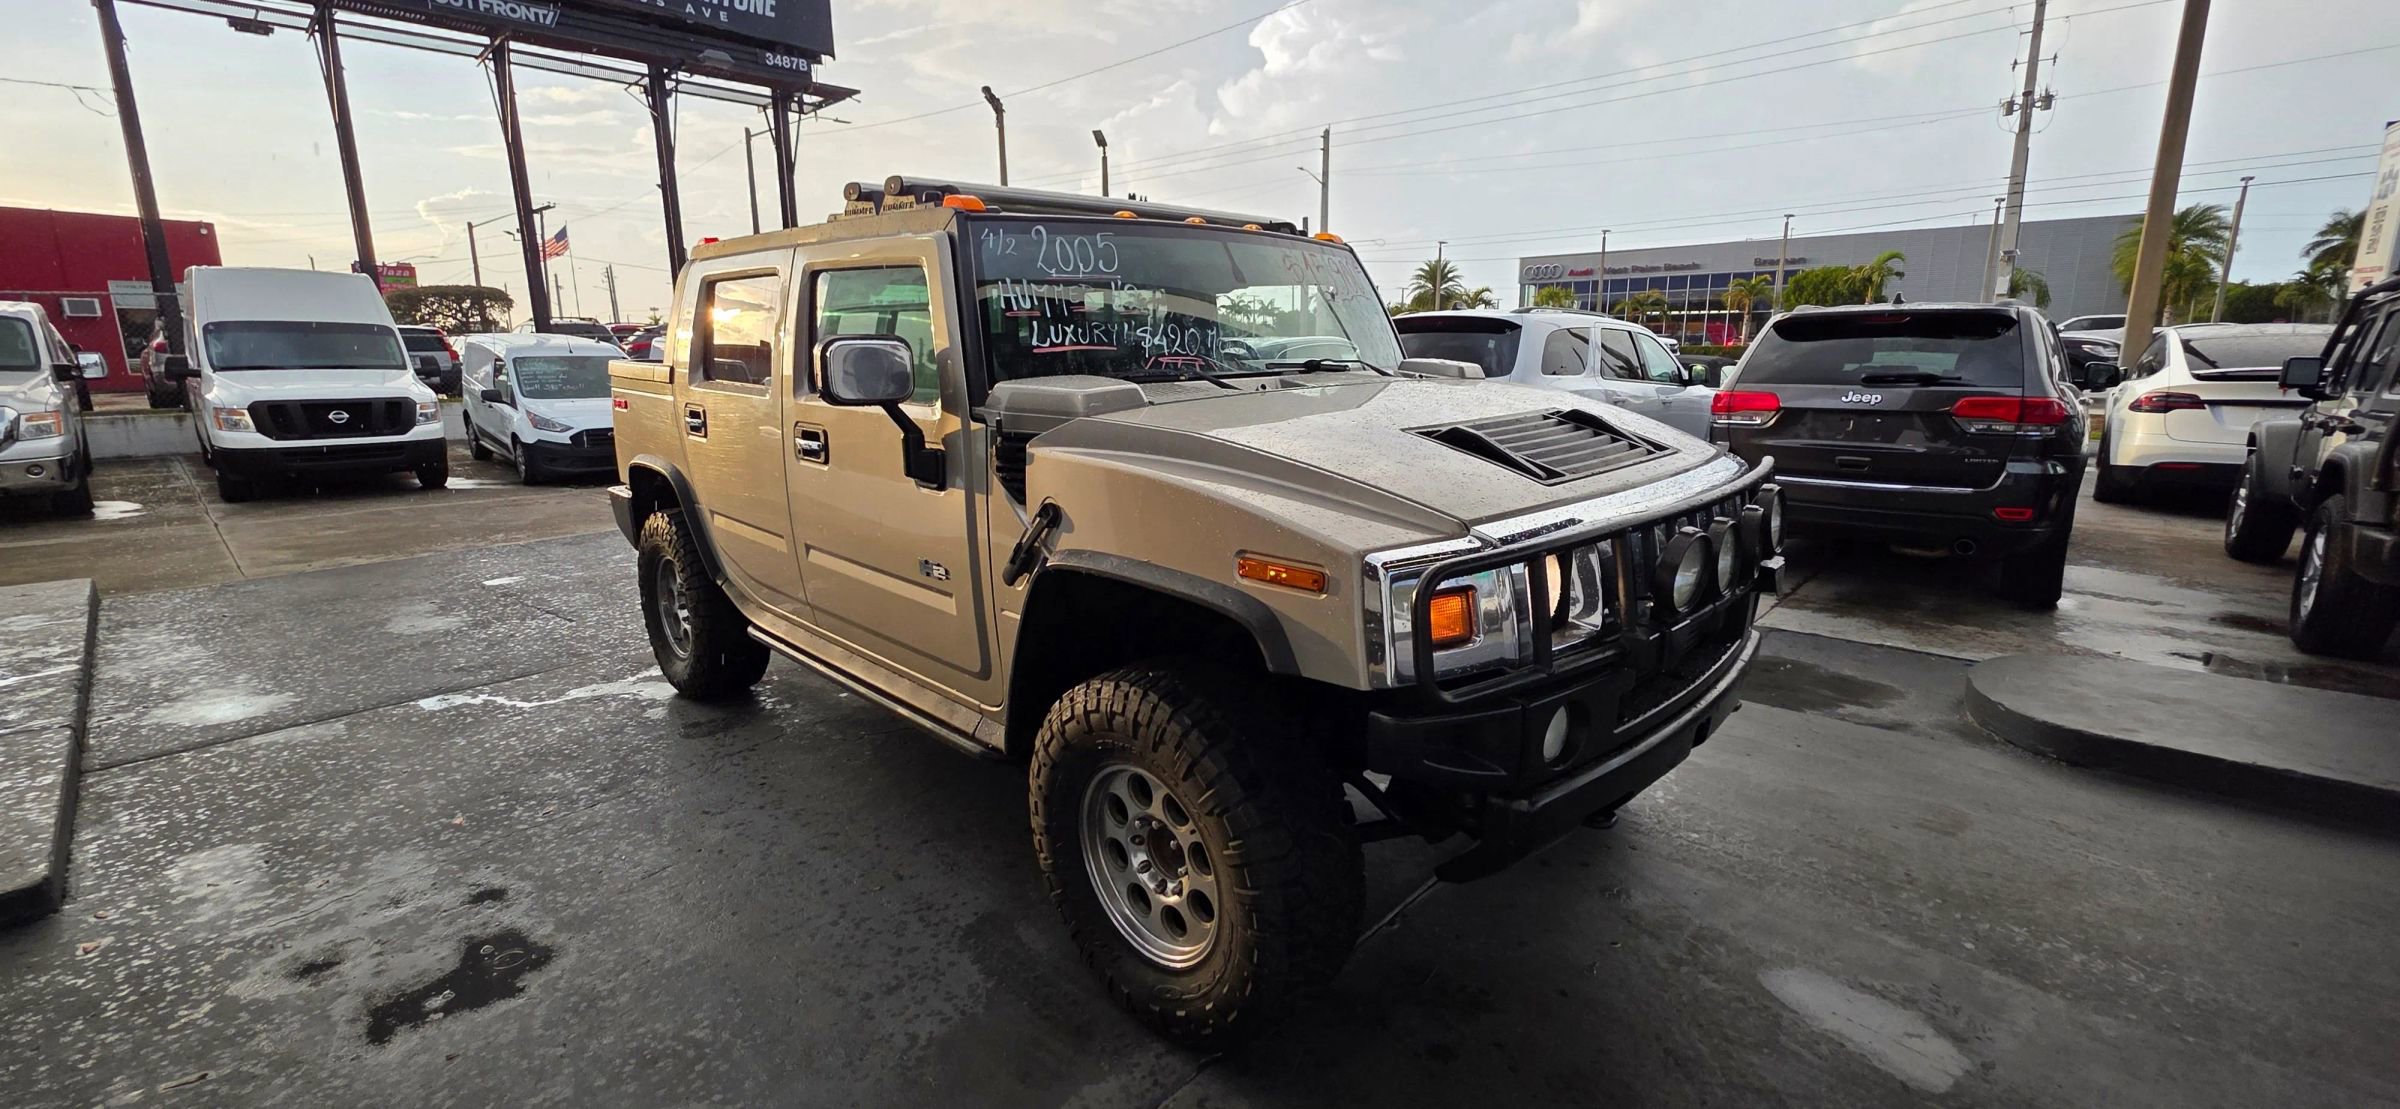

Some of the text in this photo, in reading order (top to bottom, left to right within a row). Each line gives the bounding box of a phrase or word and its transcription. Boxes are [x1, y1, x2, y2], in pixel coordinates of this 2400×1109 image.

[765, 52, 808, 71] 3487B
[1031, 225, 1119, 275] 2005
[377, 266, 410, 277] Plaza
[1567, 267, 1594, 277] Audi
[1841, 391, 1883, 405] Jeep
[918, 558, 952, 580] H2
